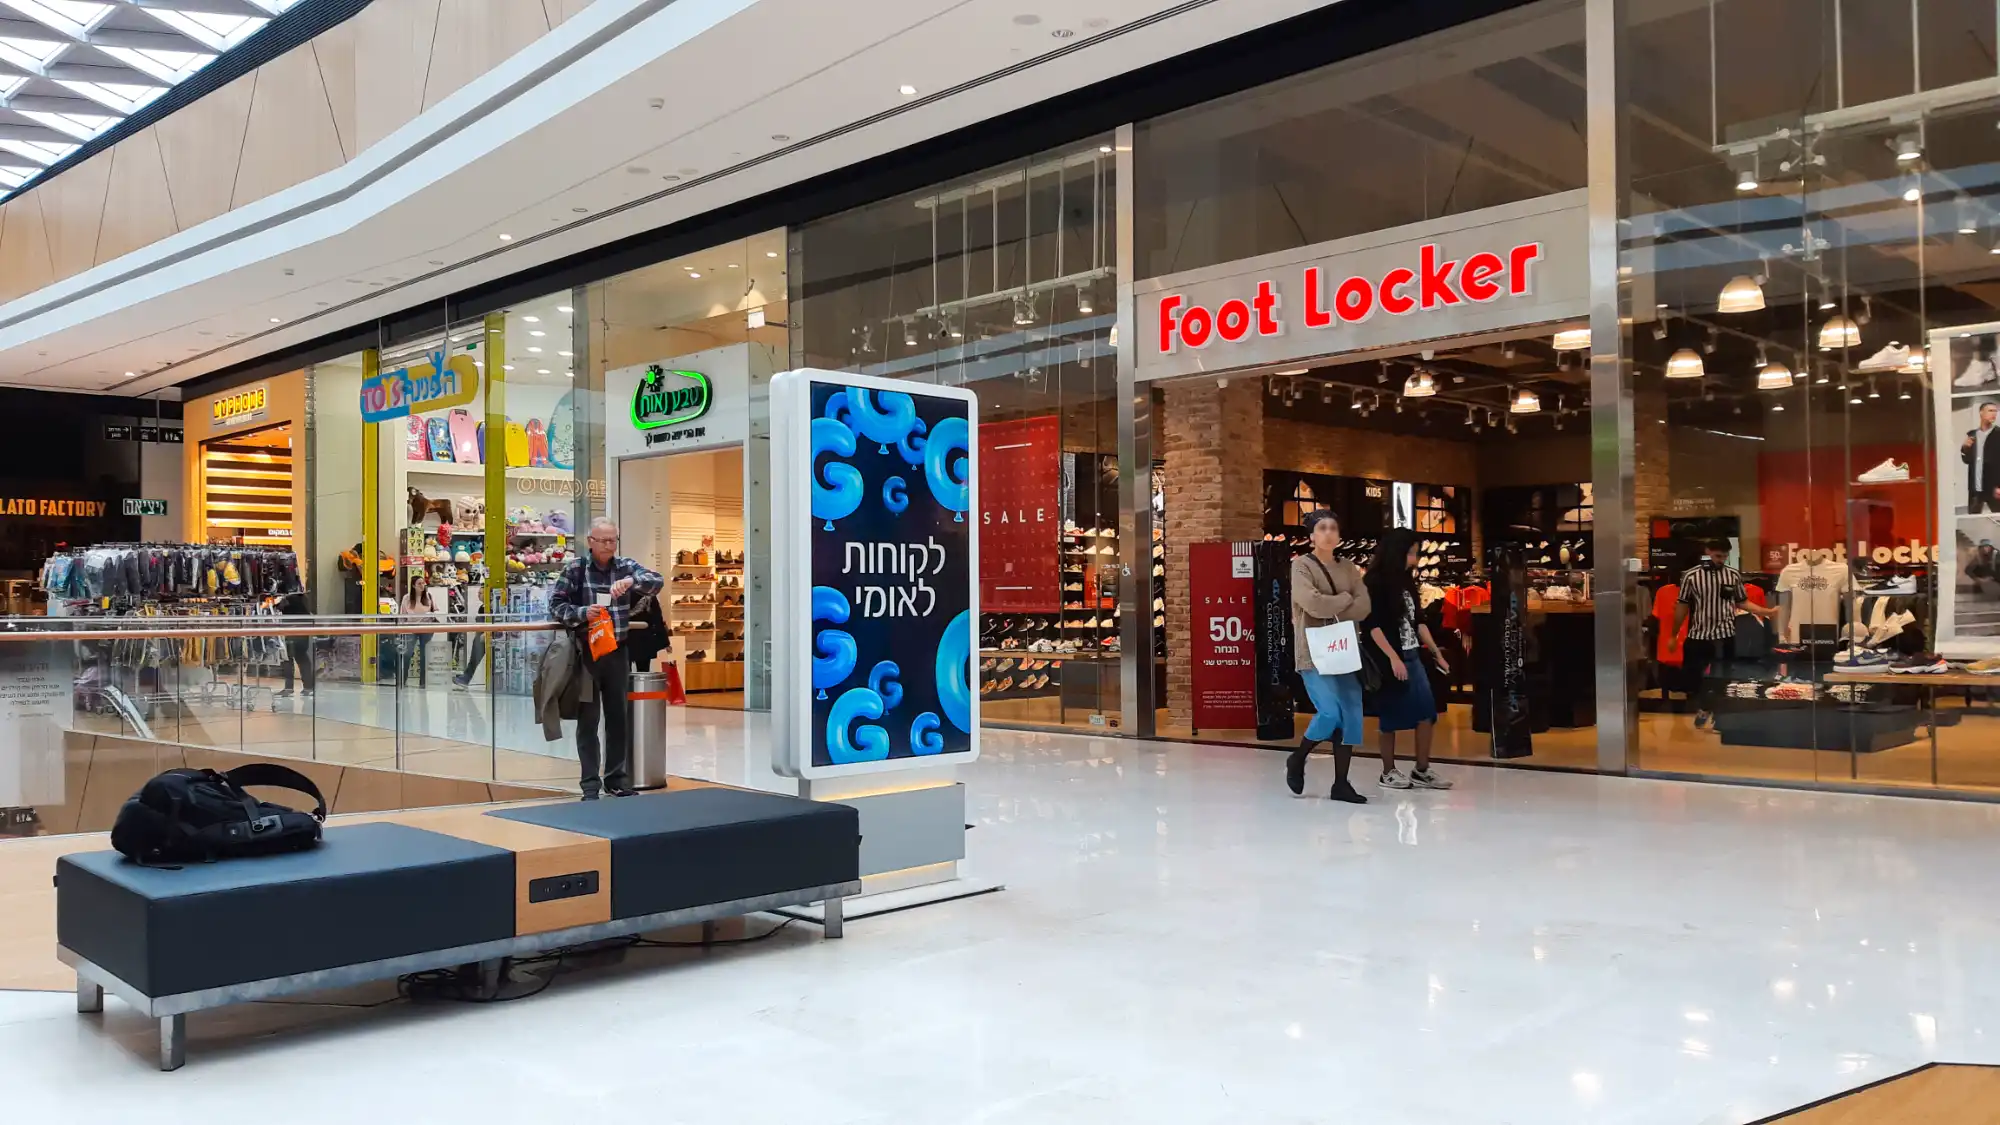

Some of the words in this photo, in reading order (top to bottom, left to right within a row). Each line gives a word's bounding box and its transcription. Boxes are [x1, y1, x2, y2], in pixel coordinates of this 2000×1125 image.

[1159, 280, 1282, 353] Foot
[1304, 242, 1543, 328] Locker
[361, 376, 401, 412] TOYS
[640, 391, 672, 417] נאות
[672, 386, 702, 411] טבע
[1365, 487, 1381, 498] KIDS
[0, 499, 36, 515] LATO
[40, 499, 106, 517] FACTORY
[125, 500, 160, 515] יציאה
[983, 508, 1045, 525] SALE
[842, 535, 946, 583] לקוחות
[855, 577, 936, 618] לאומי
[1205, 596, 1247, 604] SALE
[1209, 616, 1255, 642] 50%
[1214, 645, 1239, 654] הנחה
[1271, 605, 1280, 686] DREAMCARD
